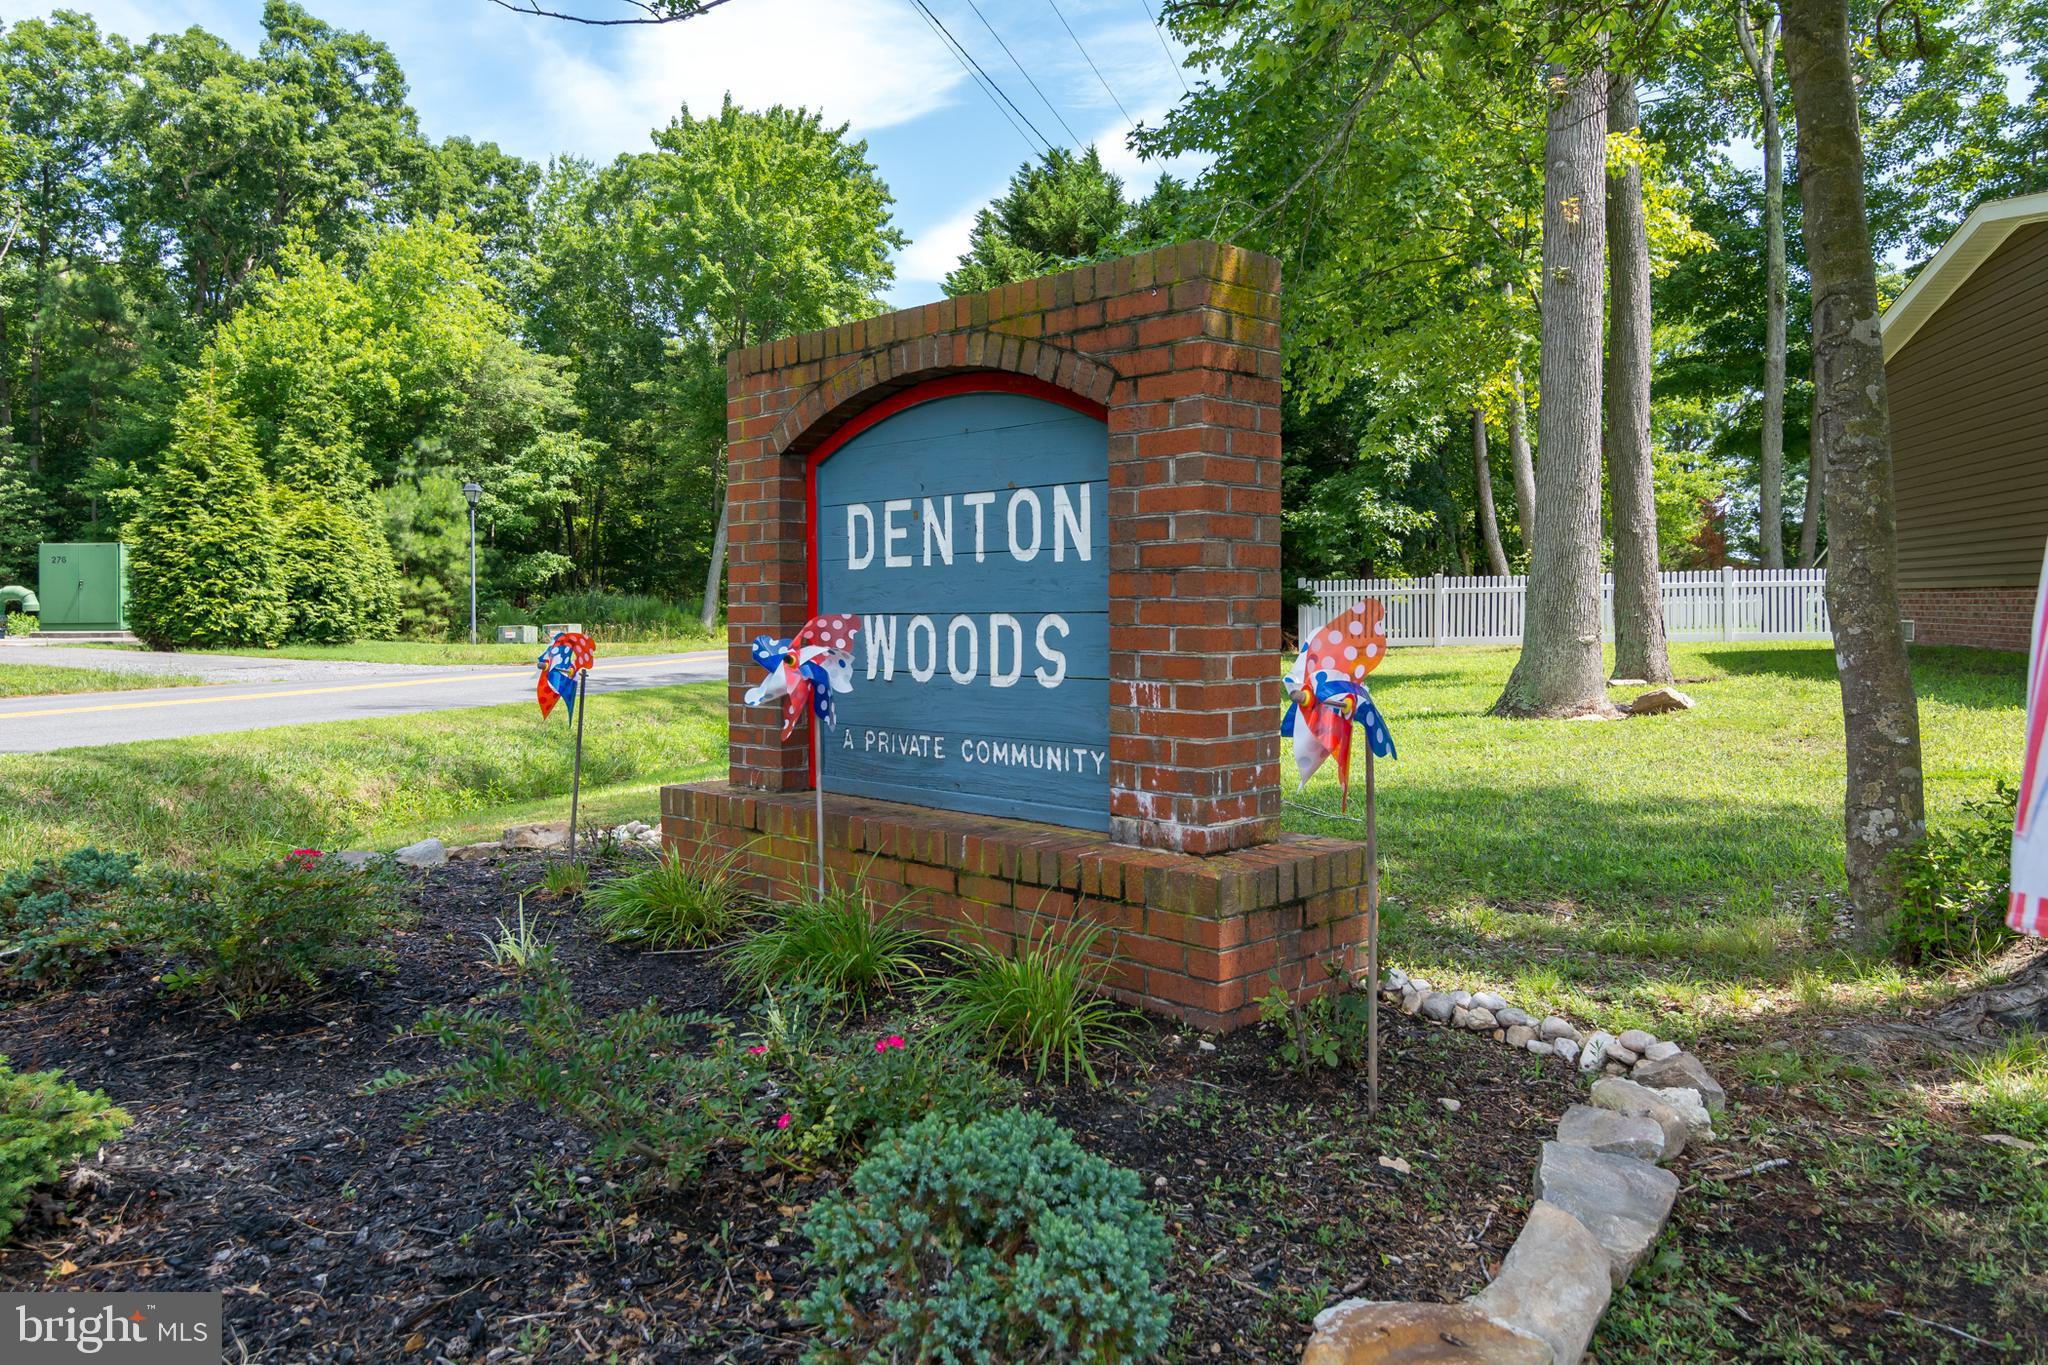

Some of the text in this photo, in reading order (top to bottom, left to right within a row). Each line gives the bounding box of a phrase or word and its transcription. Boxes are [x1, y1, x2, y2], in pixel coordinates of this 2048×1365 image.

[847, 483, 1091, 570] DENTON
[863, 613, 1070, 688] WOODS
[842, 729, 1105, 775] A PRIVATE COMMUNITY
